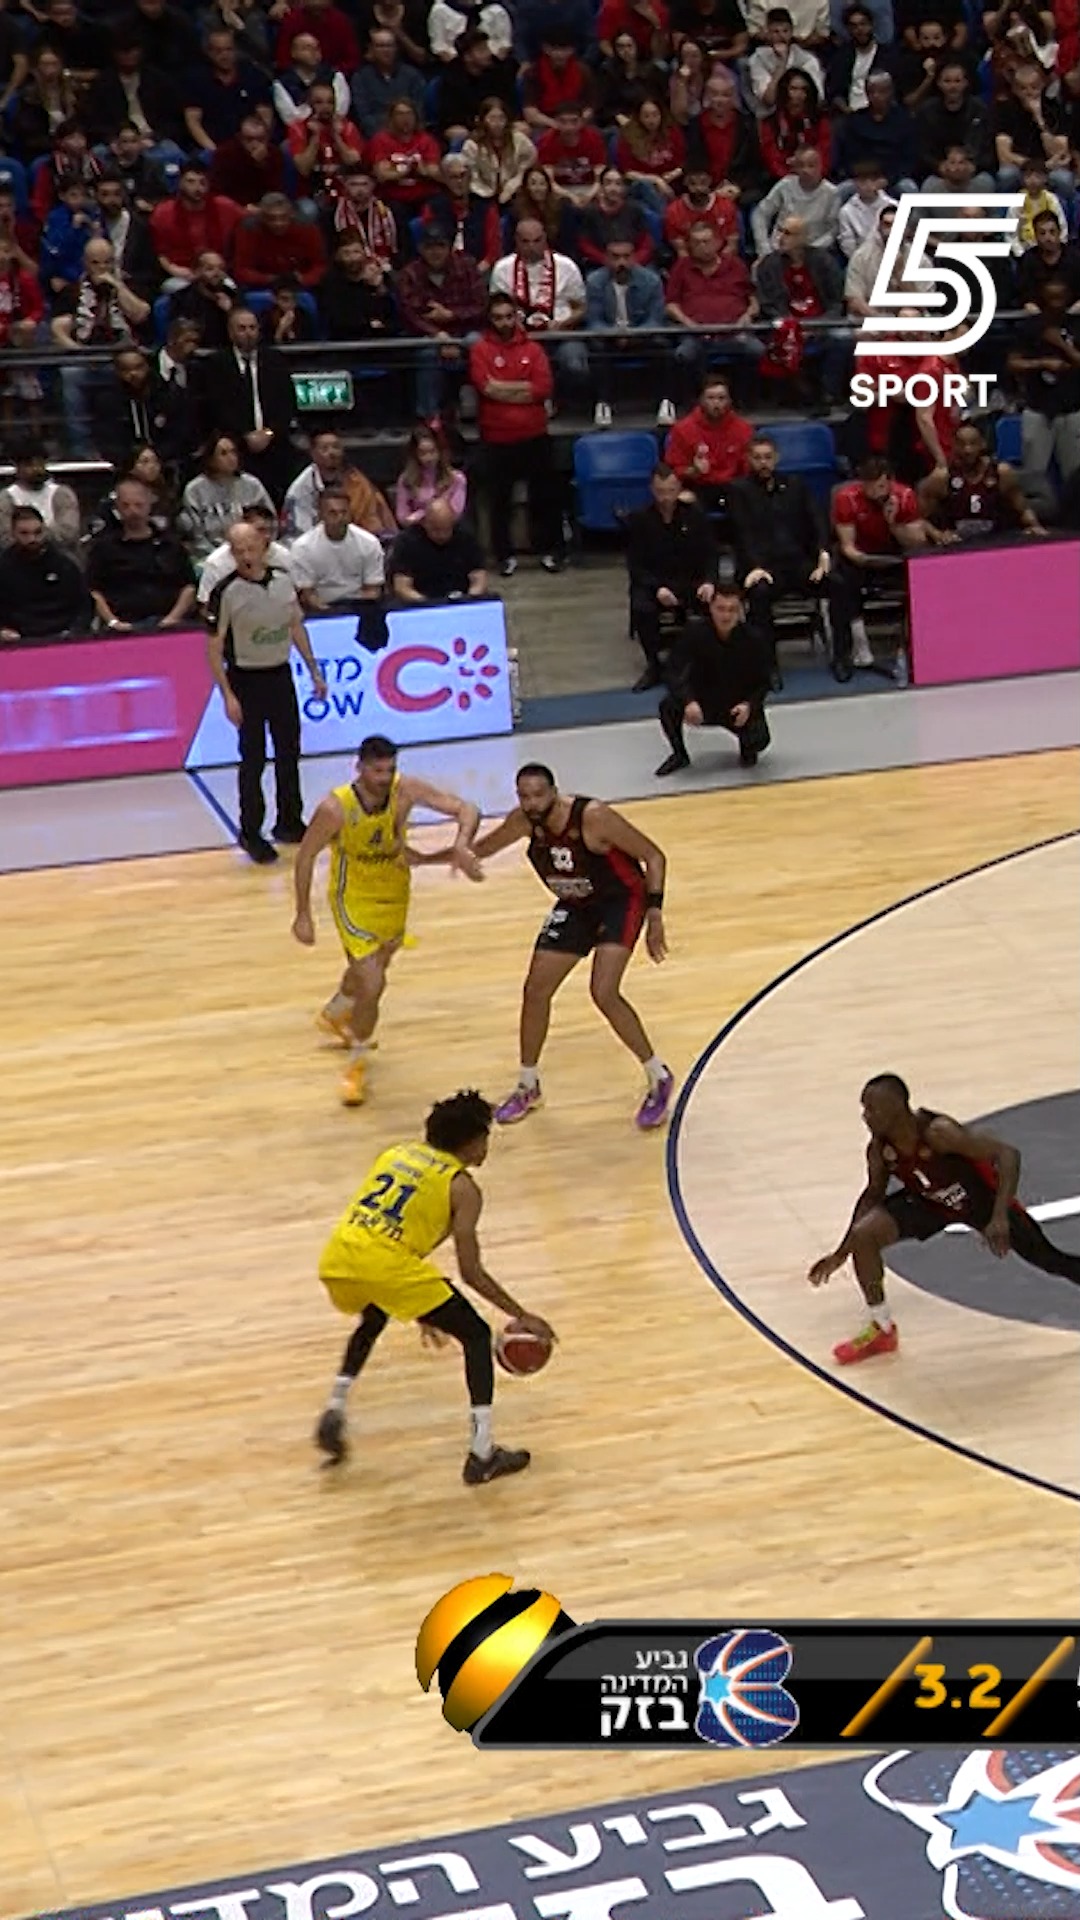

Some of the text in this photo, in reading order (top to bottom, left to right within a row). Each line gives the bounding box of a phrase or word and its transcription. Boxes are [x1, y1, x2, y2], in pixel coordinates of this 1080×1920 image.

[302, 691, 365, 722] OW
[359, 1173, 418, 1221] 21
[507, 1788, 808, 1880] גביע
